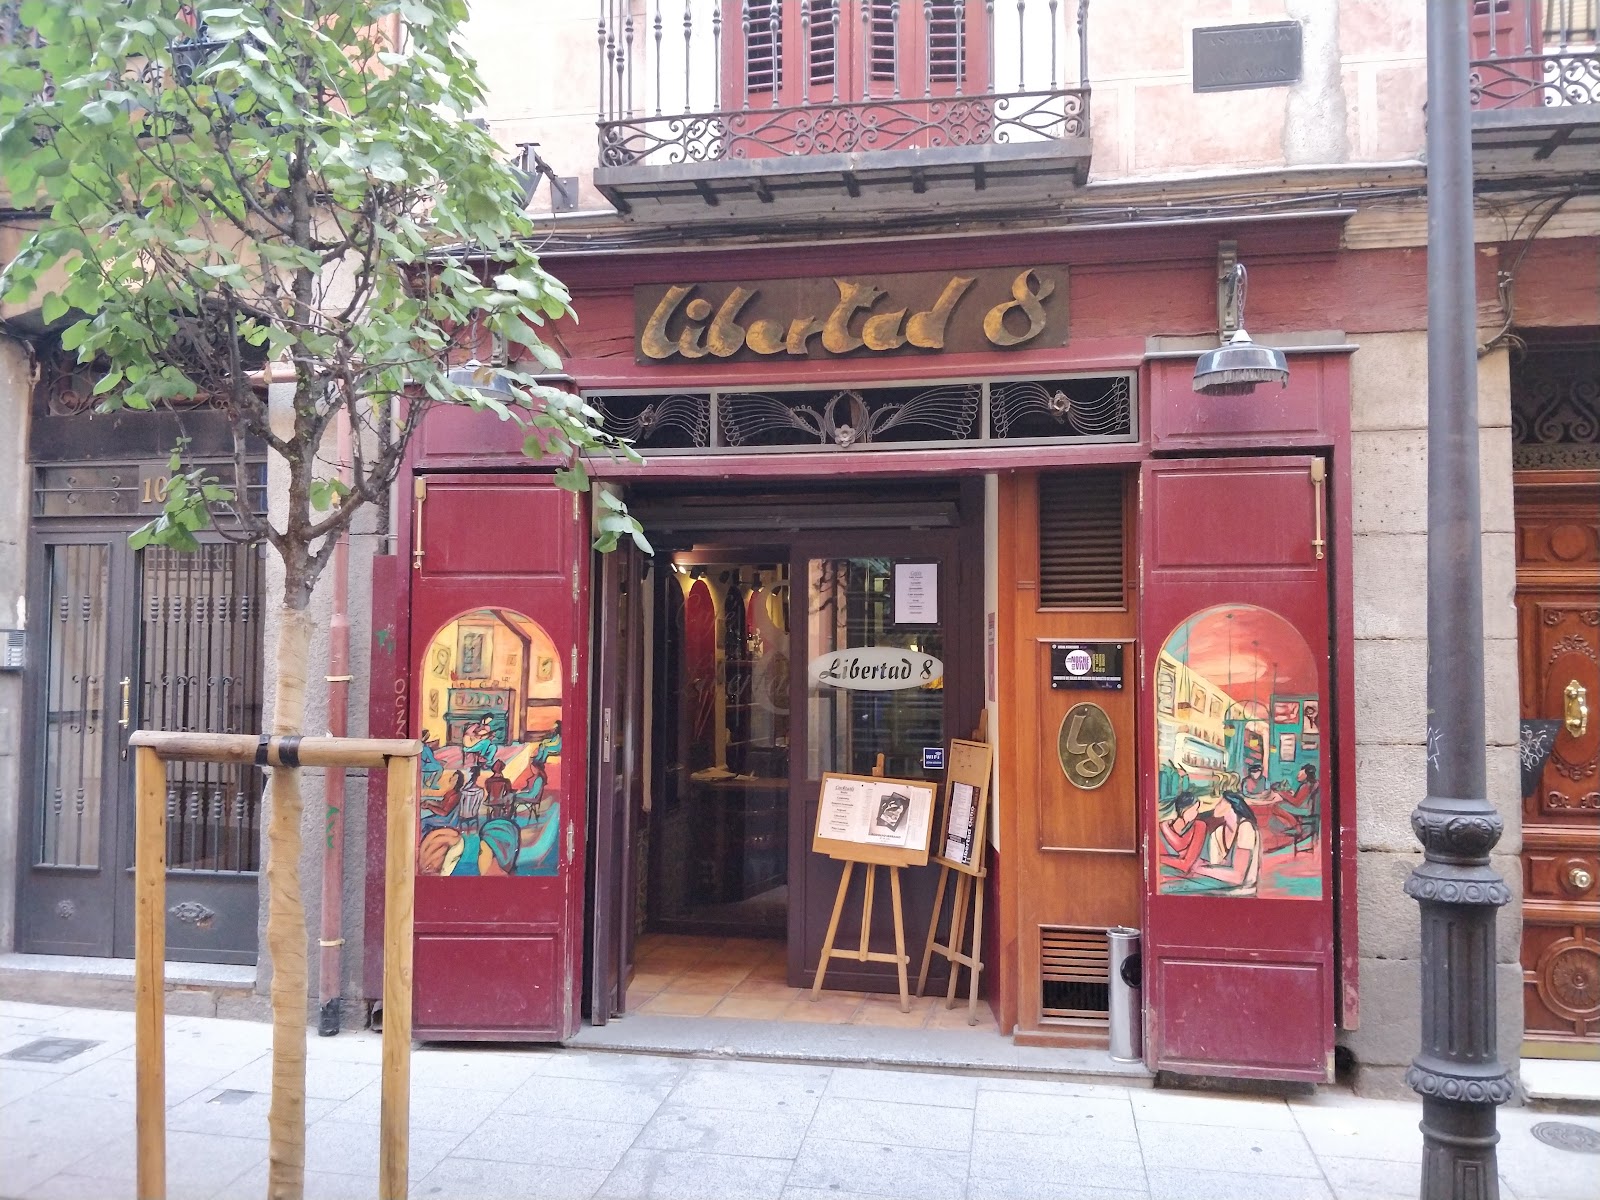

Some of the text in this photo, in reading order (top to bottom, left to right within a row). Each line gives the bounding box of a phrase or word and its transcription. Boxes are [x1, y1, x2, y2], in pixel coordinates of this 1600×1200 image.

[983, 268, 1056, 346] 8
[142, 476, 168, 503] 10
[819, 657, 933, 680] Libertad 8
